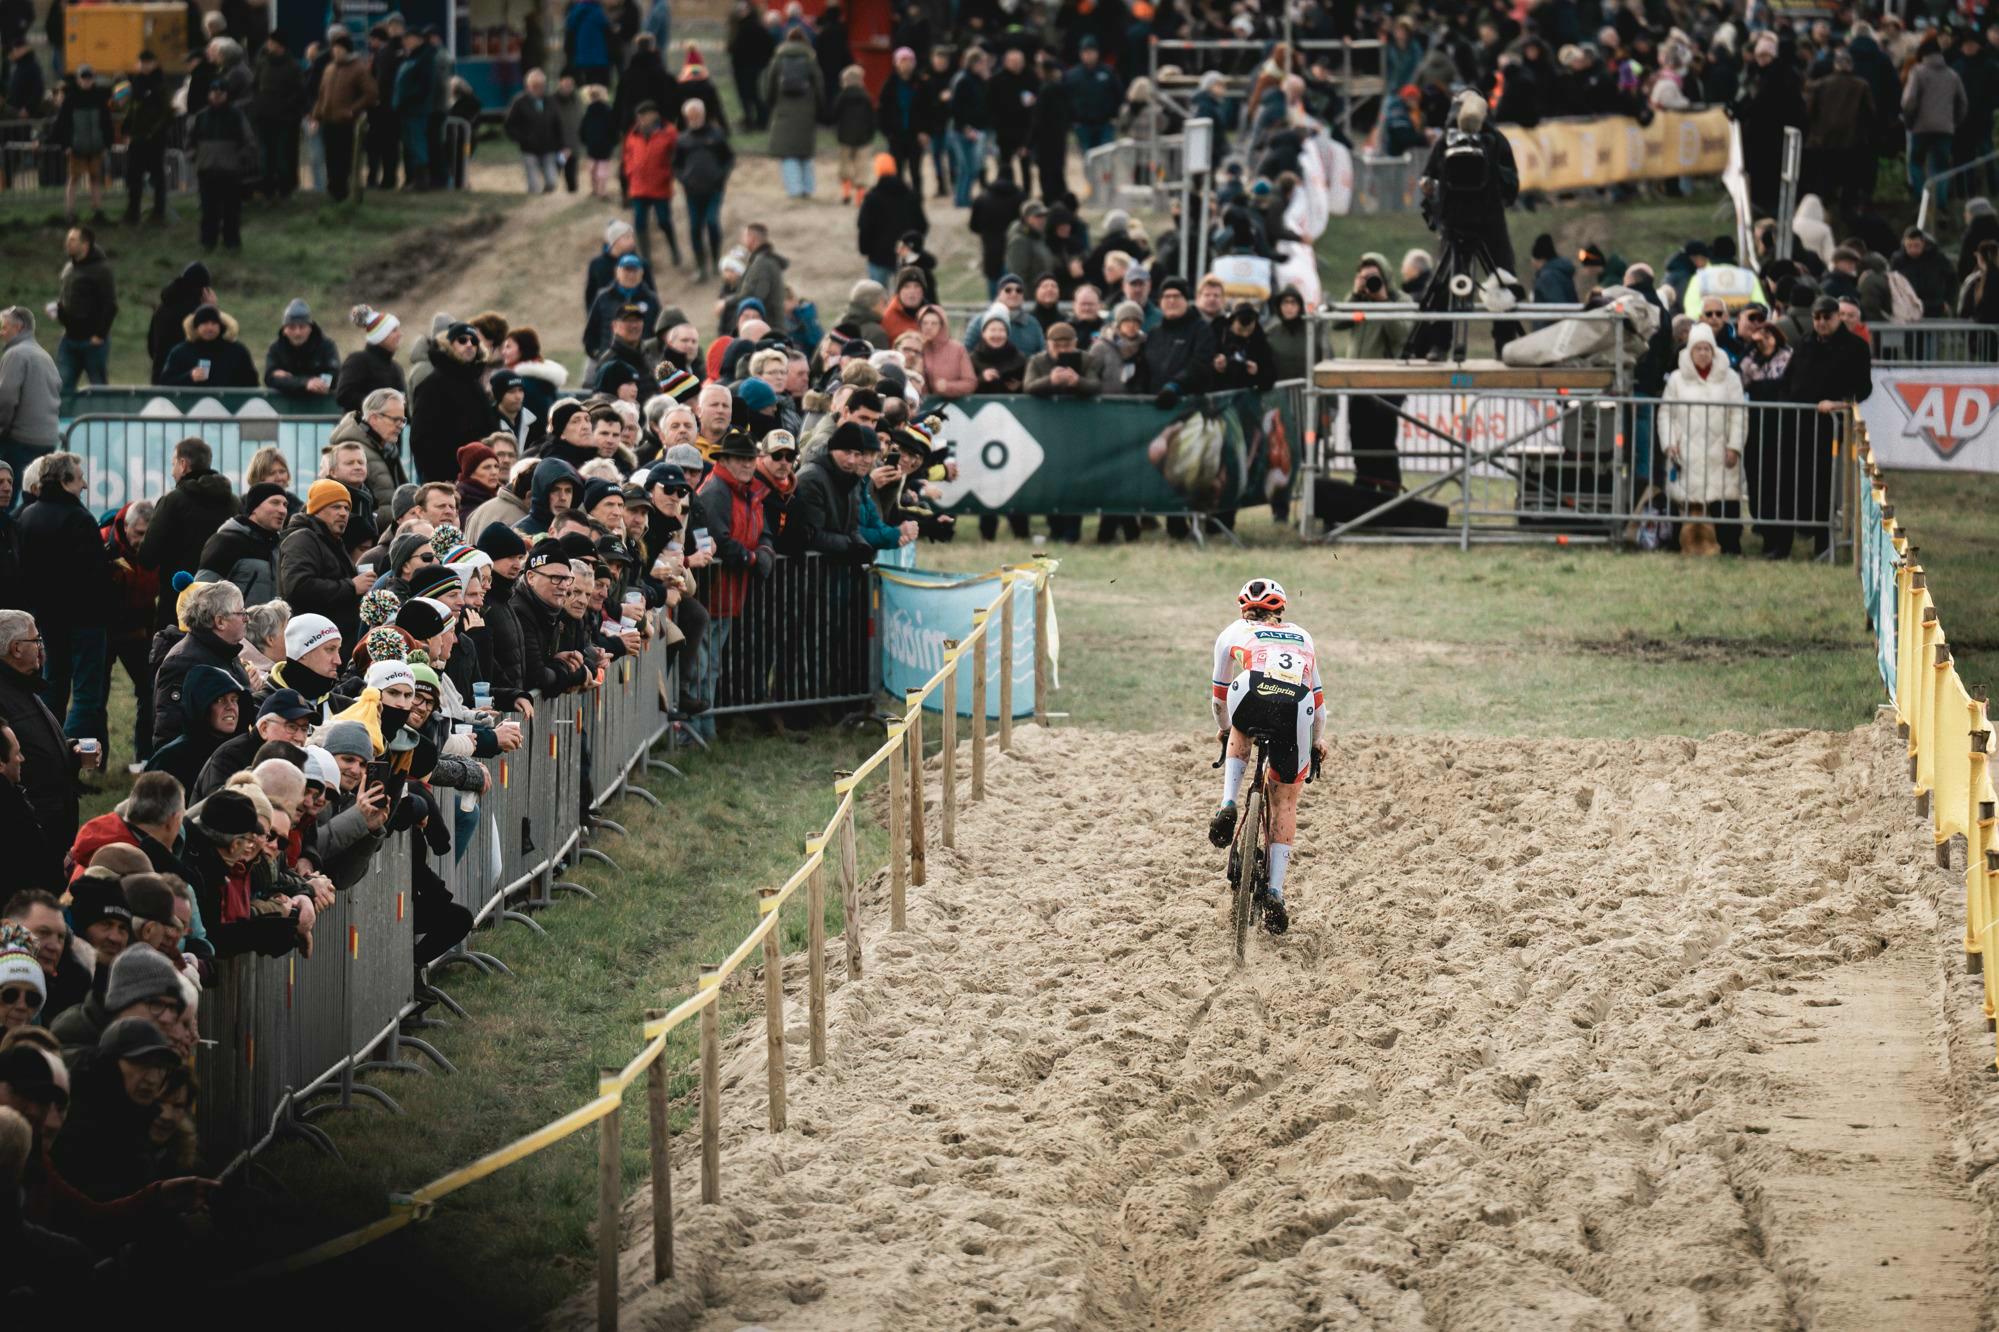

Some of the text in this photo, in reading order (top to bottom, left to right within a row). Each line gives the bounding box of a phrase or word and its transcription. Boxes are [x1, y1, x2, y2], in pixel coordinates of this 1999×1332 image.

[1903, 387, 1990, 437] AD
[531, 554, 547, 567] CAT
[1260, 631, 1303, 641] ALTEZ
[1278, 653, 1292, 669] 3
[1257, 681, 1296, 697] Andiprim
